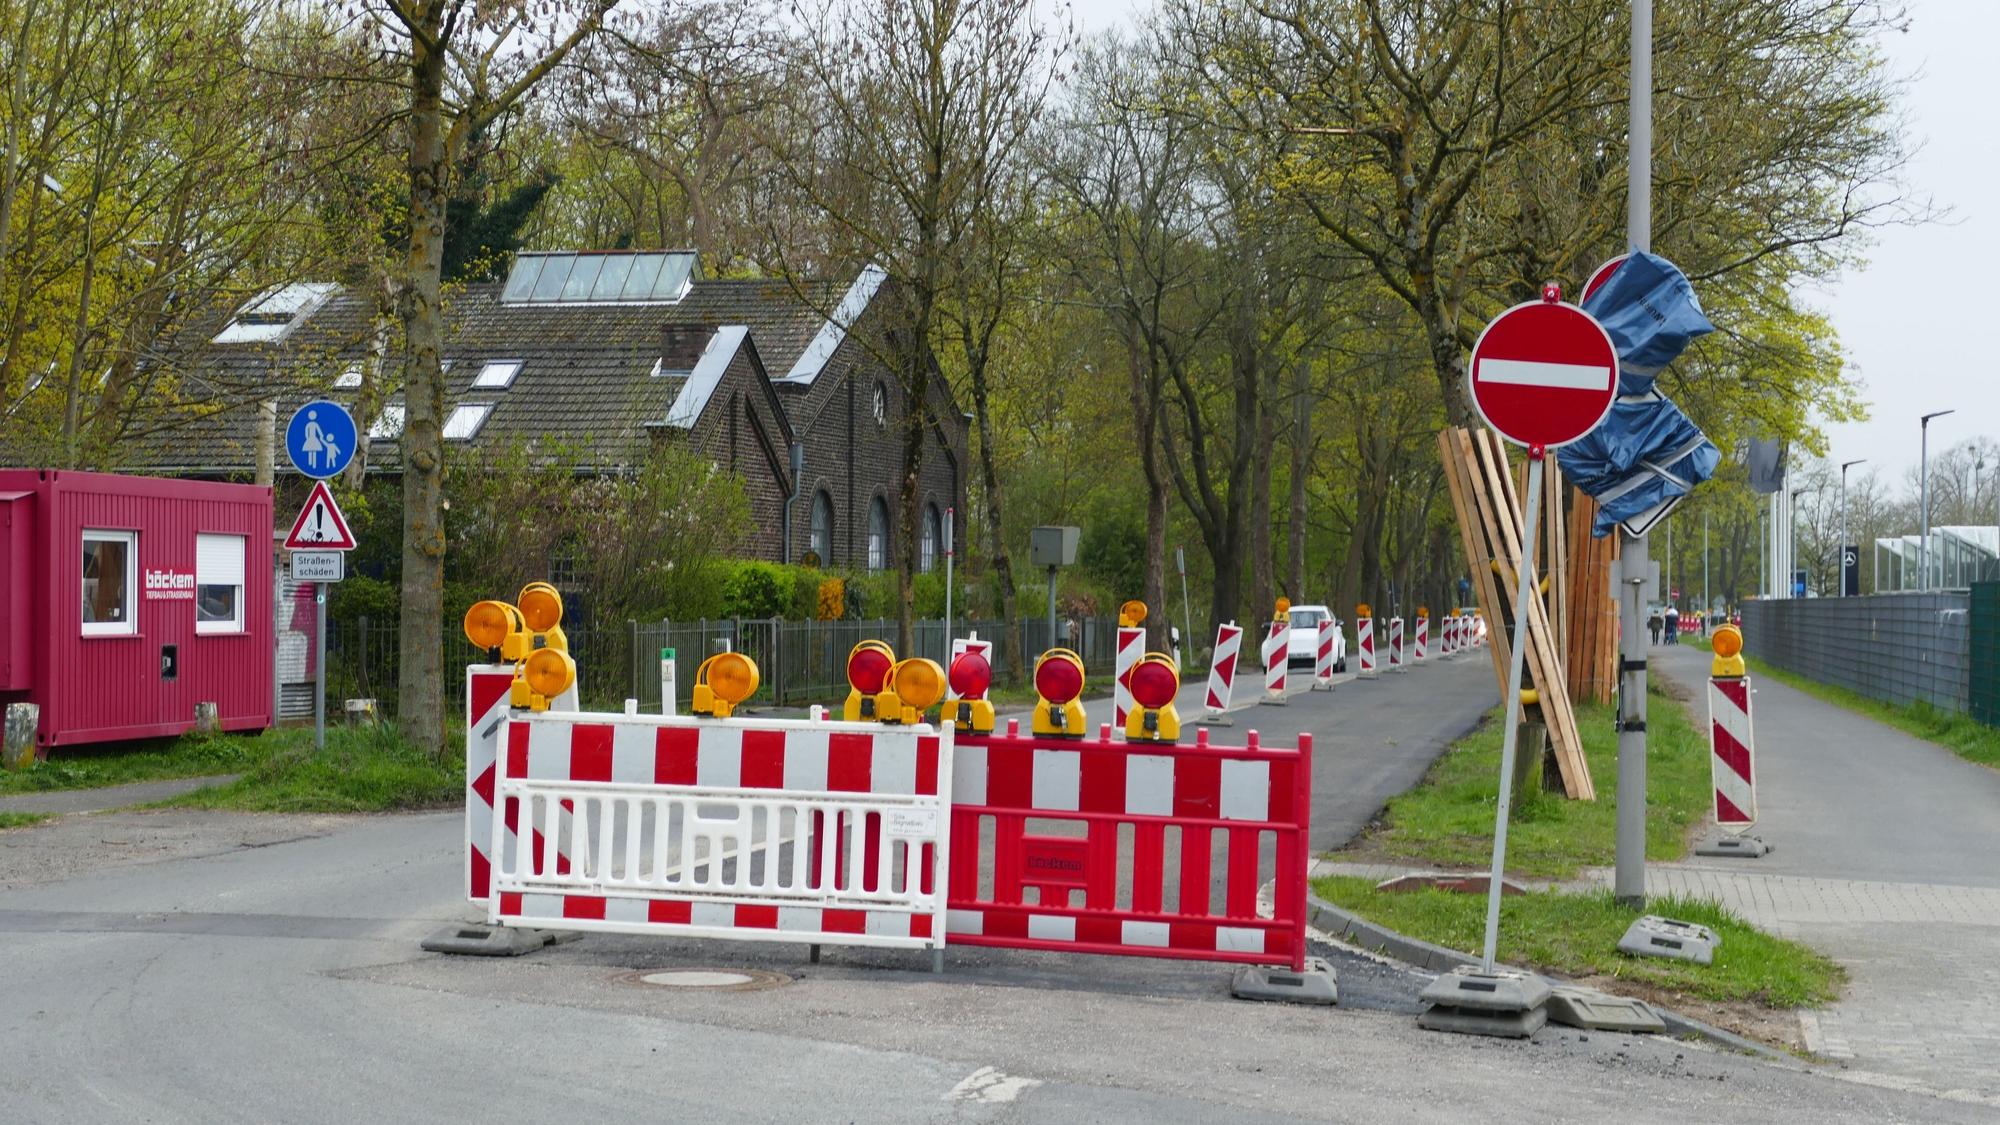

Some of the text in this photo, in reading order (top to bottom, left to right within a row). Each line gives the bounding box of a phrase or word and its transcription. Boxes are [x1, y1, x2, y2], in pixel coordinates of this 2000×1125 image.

[298, 556, 335, 565] Straßen-
[299, 567, 334, 576] schäden
[146, 569, 194, 589] böckem
